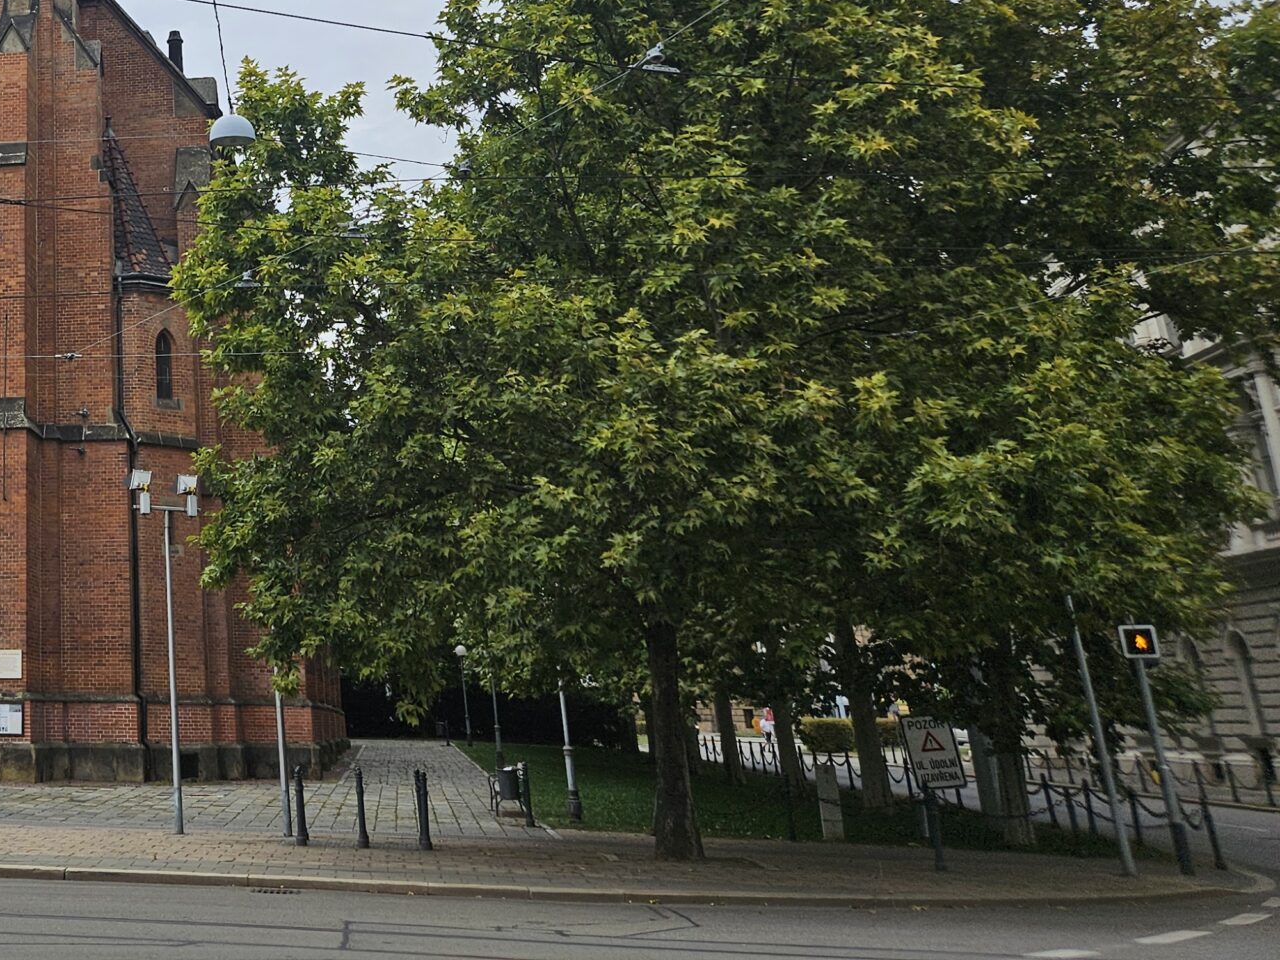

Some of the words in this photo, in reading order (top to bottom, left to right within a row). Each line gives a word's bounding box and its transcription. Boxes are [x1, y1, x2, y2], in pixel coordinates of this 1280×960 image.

[907, 719, 945, 730] POZOR
[929, 757, 959, 770] ÚDOLNÍ
[920, 771, 960, 783] UZAVŘENA
